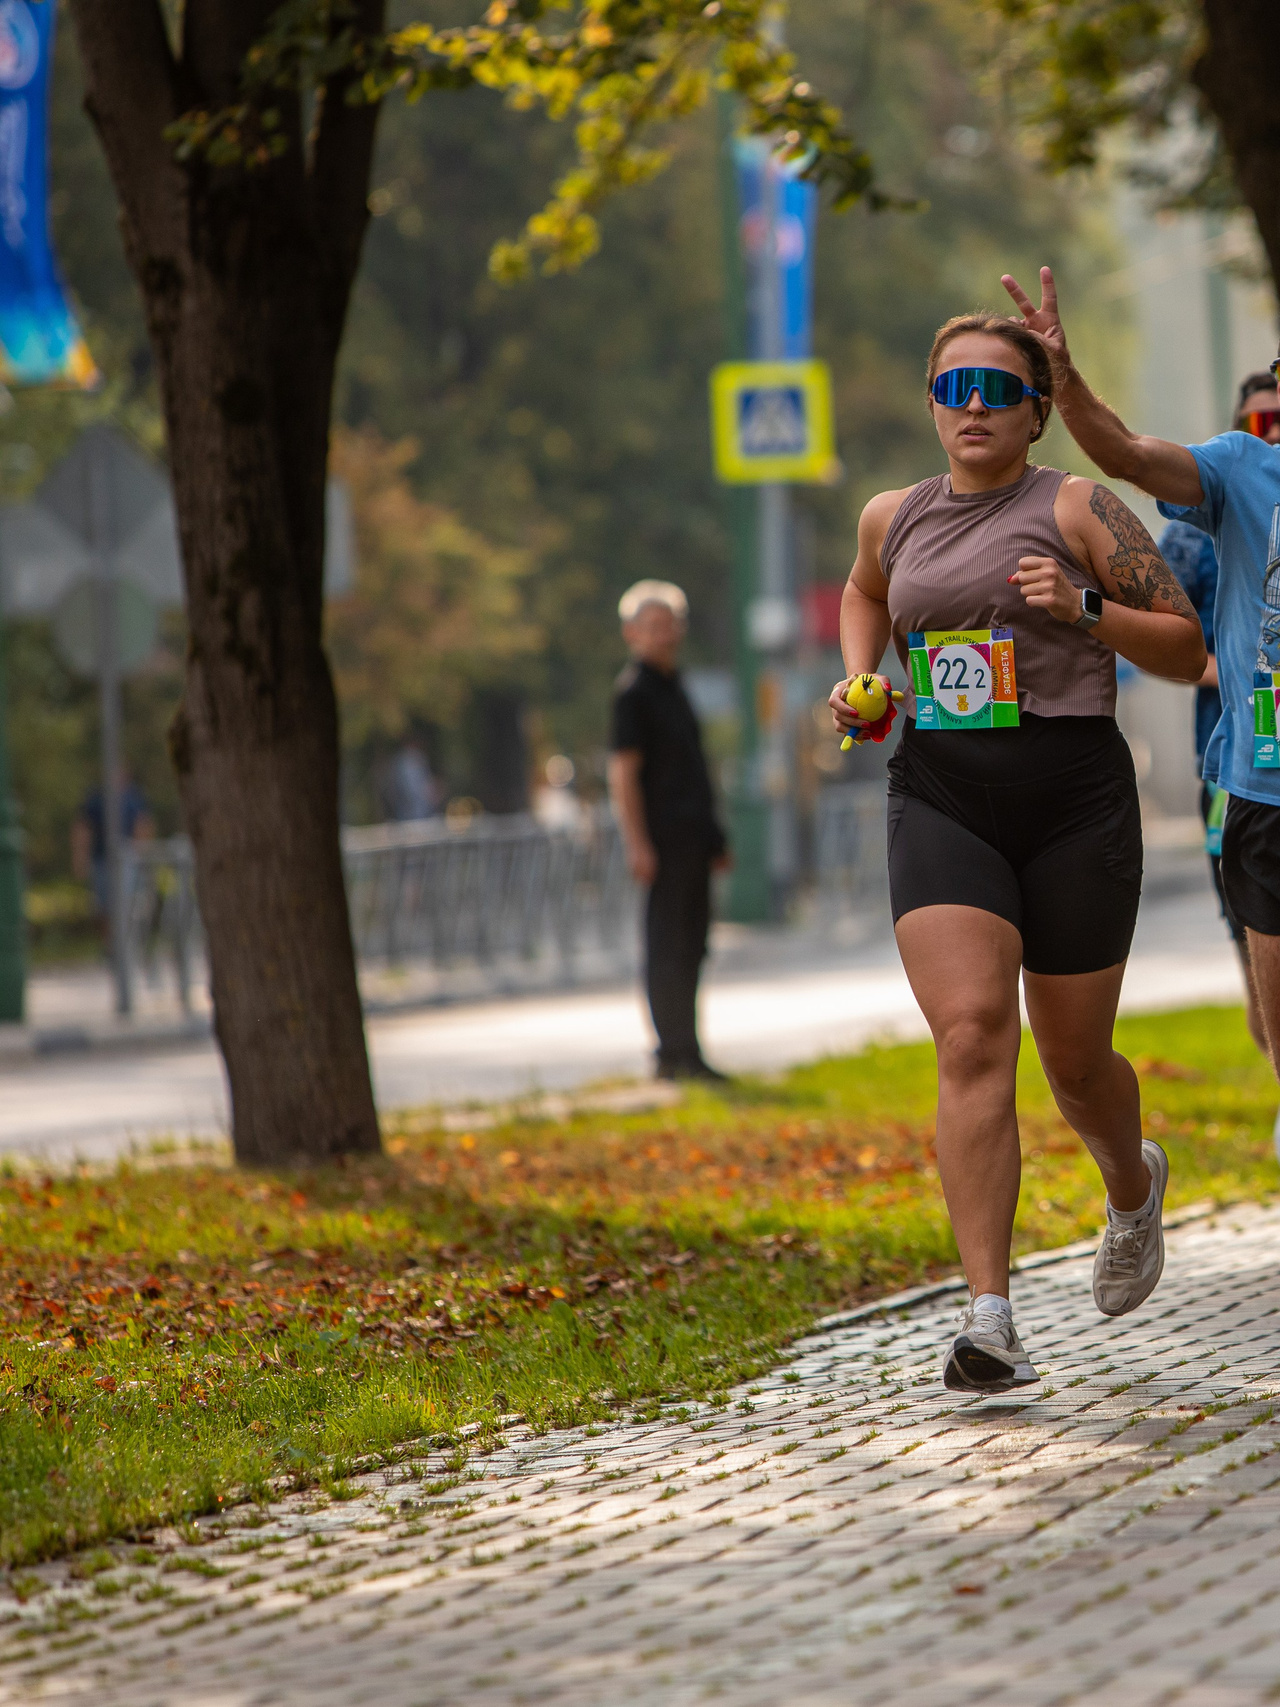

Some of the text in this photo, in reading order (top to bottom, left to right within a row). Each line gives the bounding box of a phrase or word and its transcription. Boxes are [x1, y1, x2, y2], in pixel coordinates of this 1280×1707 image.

[929, 635, 988, 660] DREAM TRAIL LYSKOVO
[936, 657, 986, 689] 22 2
[1001, 650, 1011, 695] ЭСТАФЕТА
[940, 708, 962, 725] KANNAS
[971, 711, 984, 722] ЛЕС
